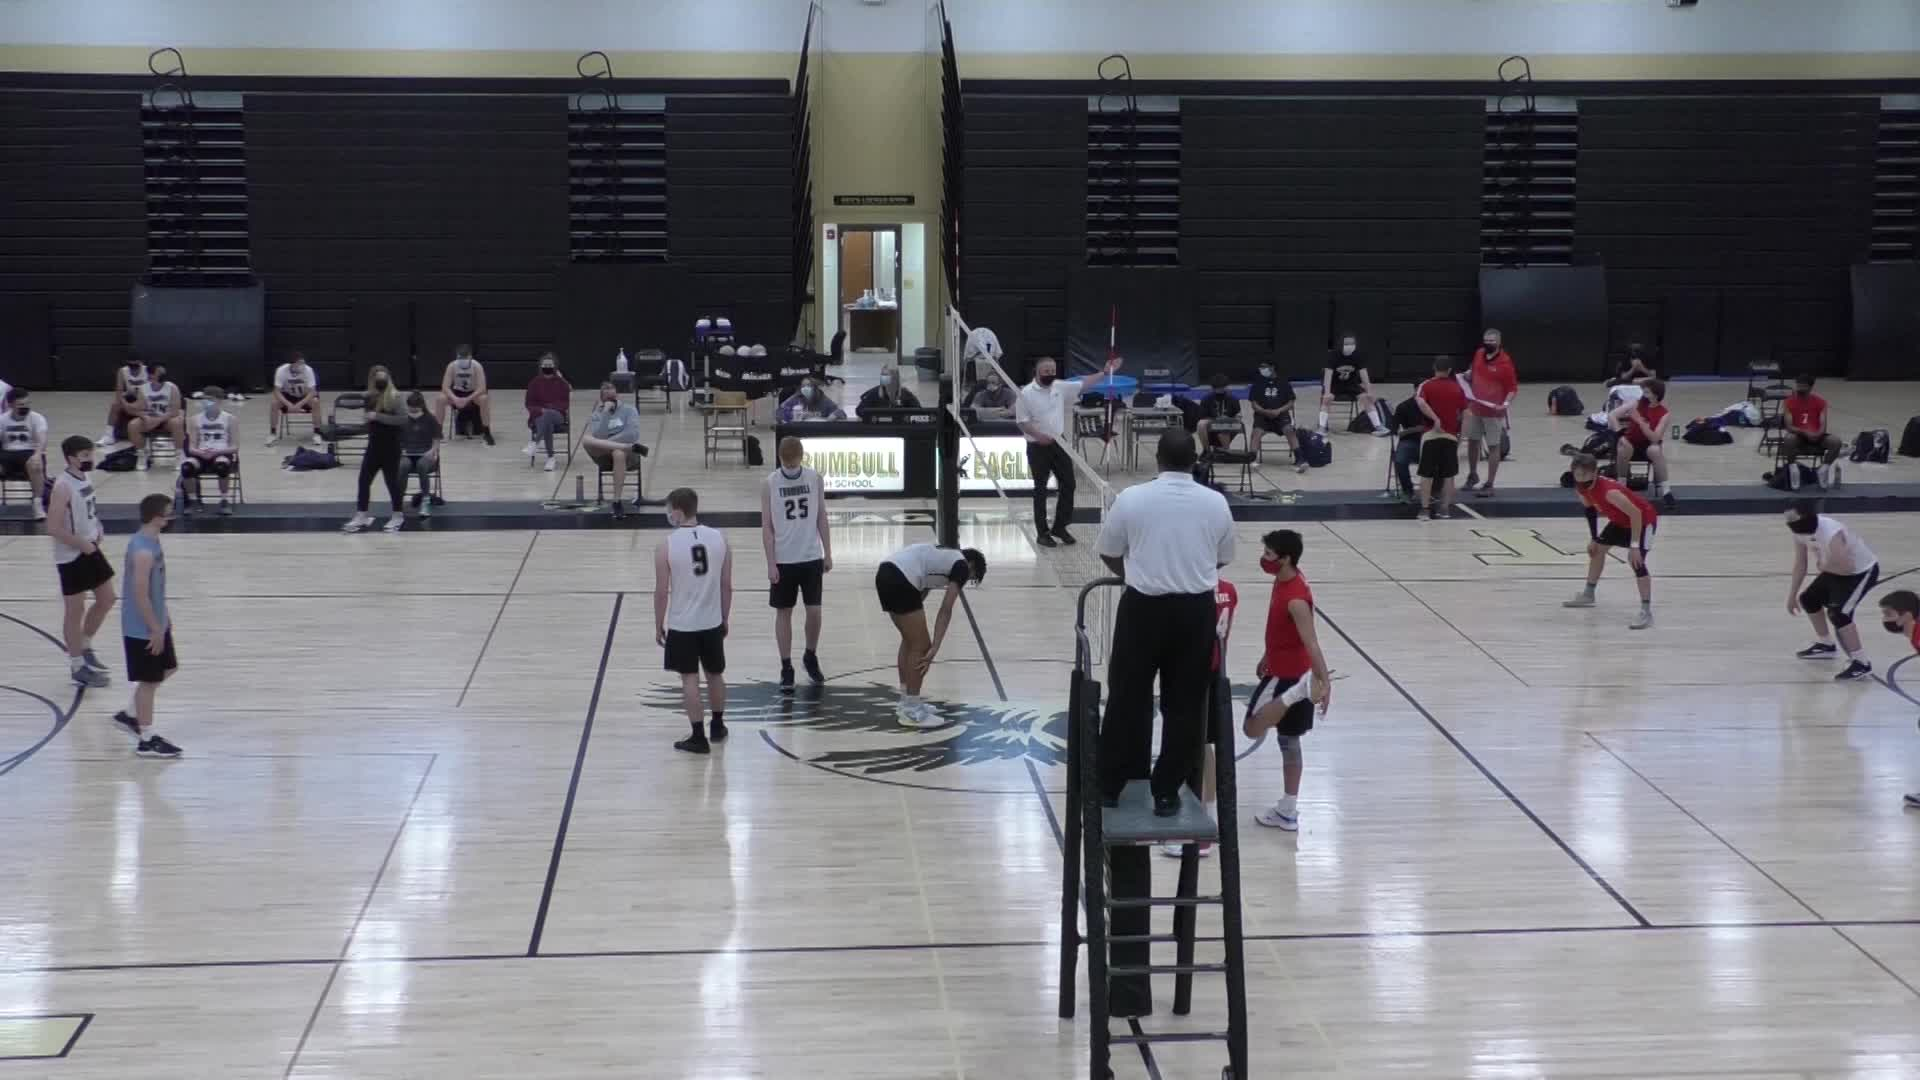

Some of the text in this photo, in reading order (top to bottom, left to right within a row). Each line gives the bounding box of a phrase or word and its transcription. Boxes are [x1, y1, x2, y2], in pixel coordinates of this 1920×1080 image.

[802, 451, 900, 478] RUMBULL
[974, 450, 1034, 480] EAGL
[835, 479, 875, 488] SCHOOL
[784, 498, 809, 520] 25
[690, 543, 709, 577] 9
